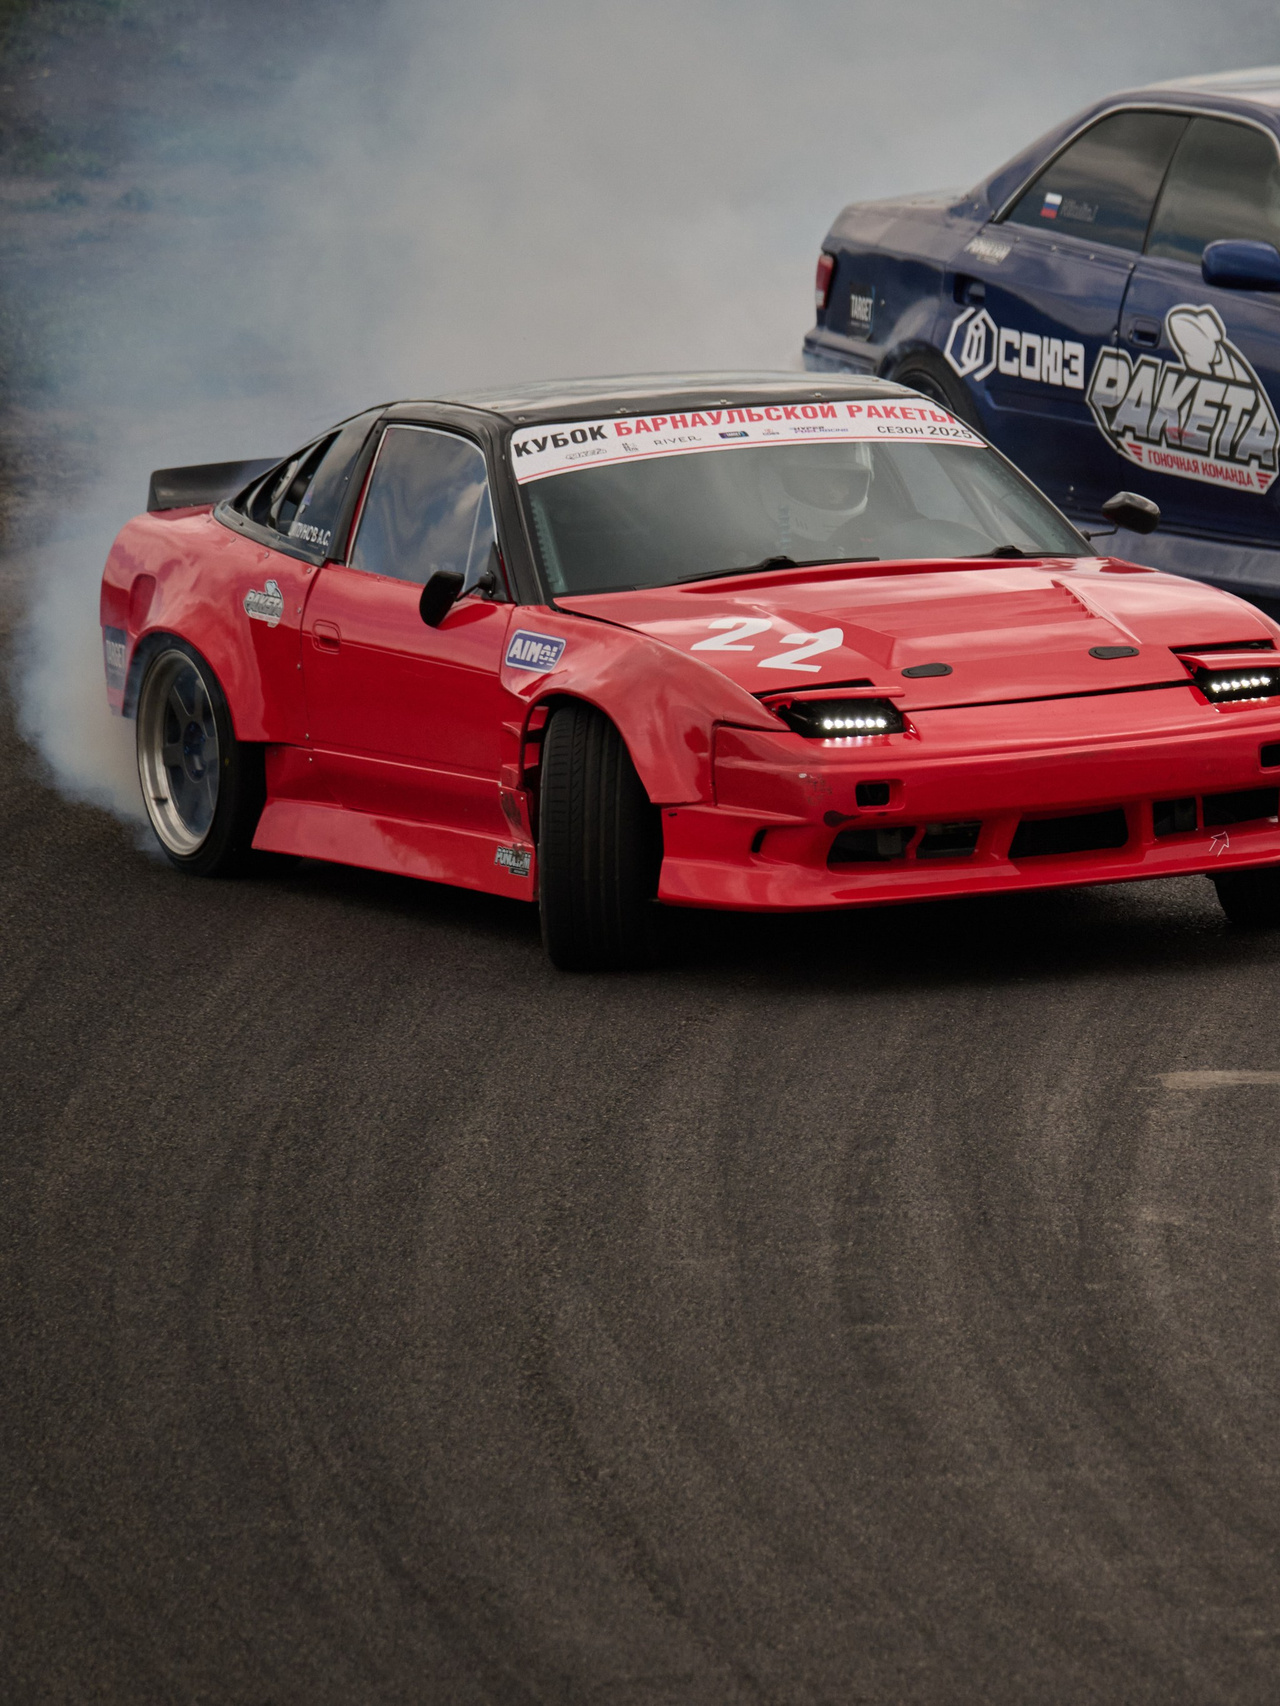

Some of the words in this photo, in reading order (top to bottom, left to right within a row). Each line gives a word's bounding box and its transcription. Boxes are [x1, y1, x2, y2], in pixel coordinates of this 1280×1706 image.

[1000, 326, 1085, 390] СОЮЗ
[513, 425, 607, 457] КУБОК
[614, 402, 837, 437] БАРНАУЛЬСКОЙ
[846, 404, 956, 425] РАКЕТЫ
[877, 425, 924, 435] СЕЗОН
[927, 425, 973, 439] 2025
[1090, 352, 1277, 470] РАКЕТА
[1148, 450, 1200, 474] ГОНОЧНАЯ
[1201, 462, 1254, 487] КОМАНДА
[508, 638, 558, 667] AIMOL
